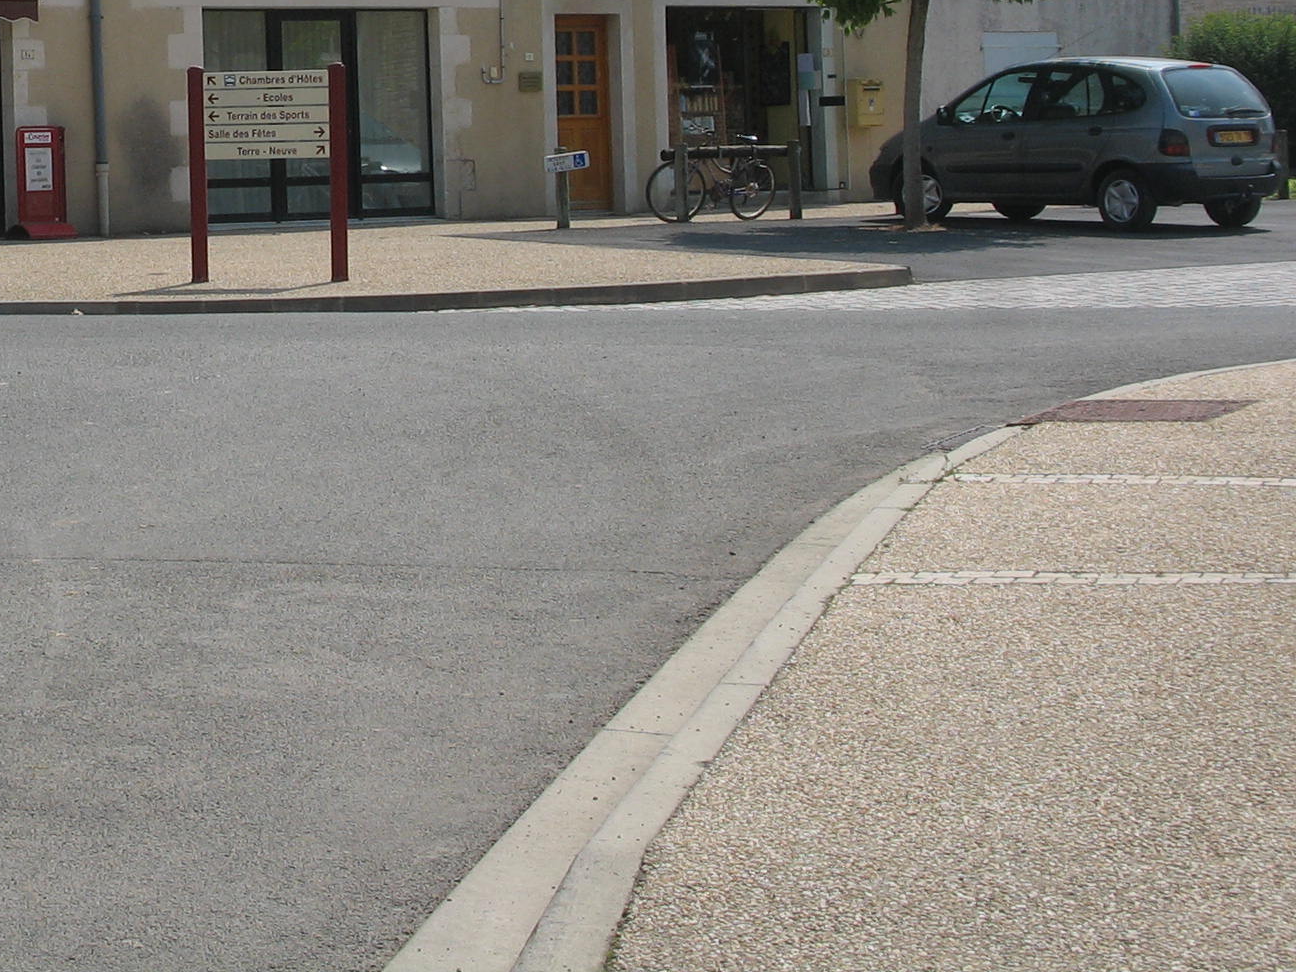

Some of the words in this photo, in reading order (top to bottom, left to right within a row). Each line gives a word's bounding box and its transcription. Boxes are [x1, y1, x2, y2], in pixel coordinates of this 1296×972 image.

[239, 75, 286, 85] Chambres
[288, 74, 323, 84] d'Hôtes
[263, 93, 294, 102] Ecoles
[227, 111, 258, 121] Terrain
[260, 111, 277, 119] des
[279, 110, 310, 121] Sports
[208, 129, 230, 139] Salle
[233, 129, 250, 138] des
[252, 128, 276, 138] Fêtes
[237, 147, 260, 156] Terre
[269, 146, 297, 156] Neuve
